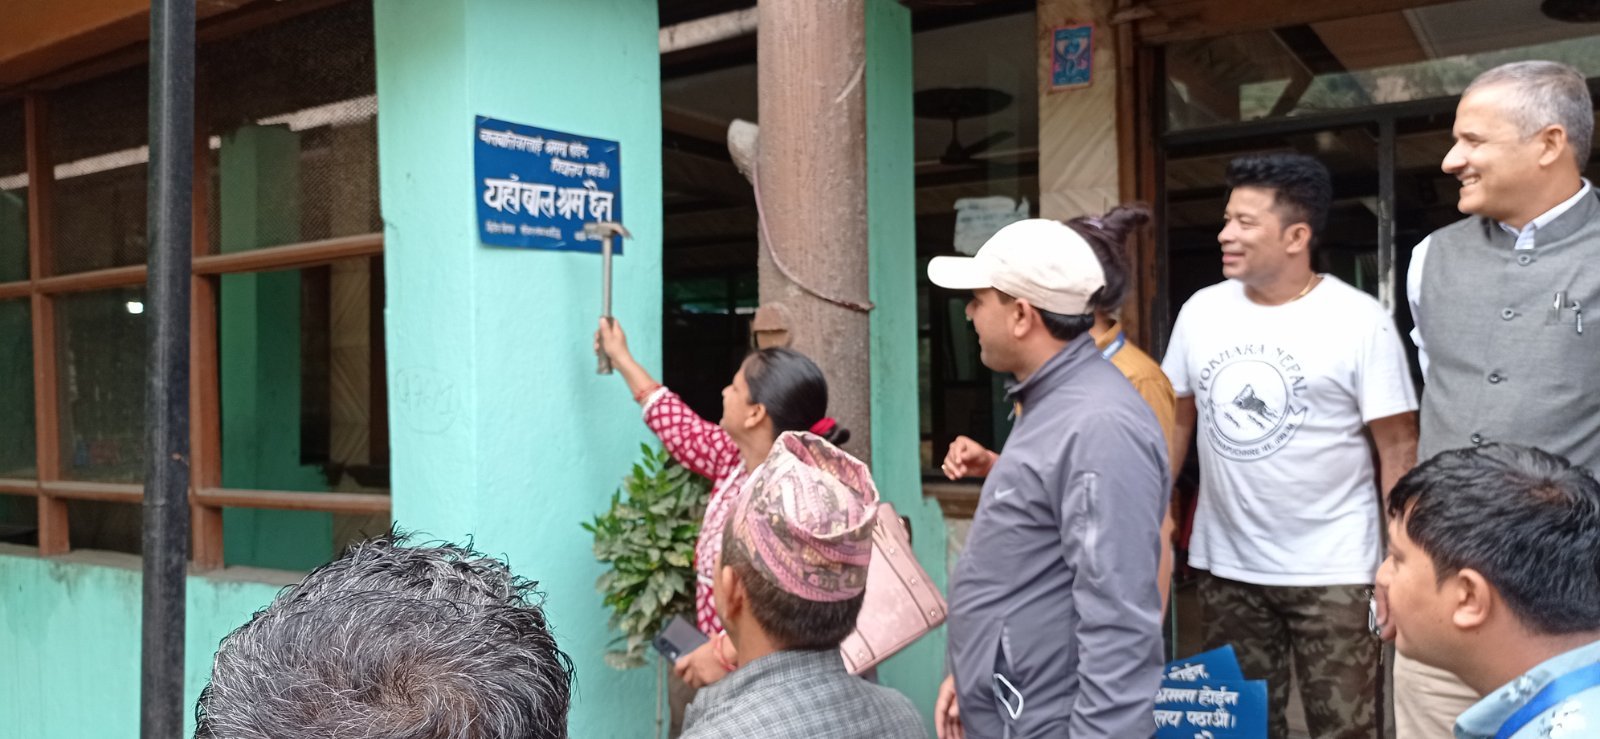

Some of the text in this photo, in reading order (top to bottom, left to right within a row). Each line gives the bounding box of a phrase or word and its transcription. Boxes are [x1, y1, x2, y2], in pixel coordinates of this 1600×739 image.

[556, 187, 587, 220] श्रम
[1198, 344, 1308, 398] POKHARA NEPAL
